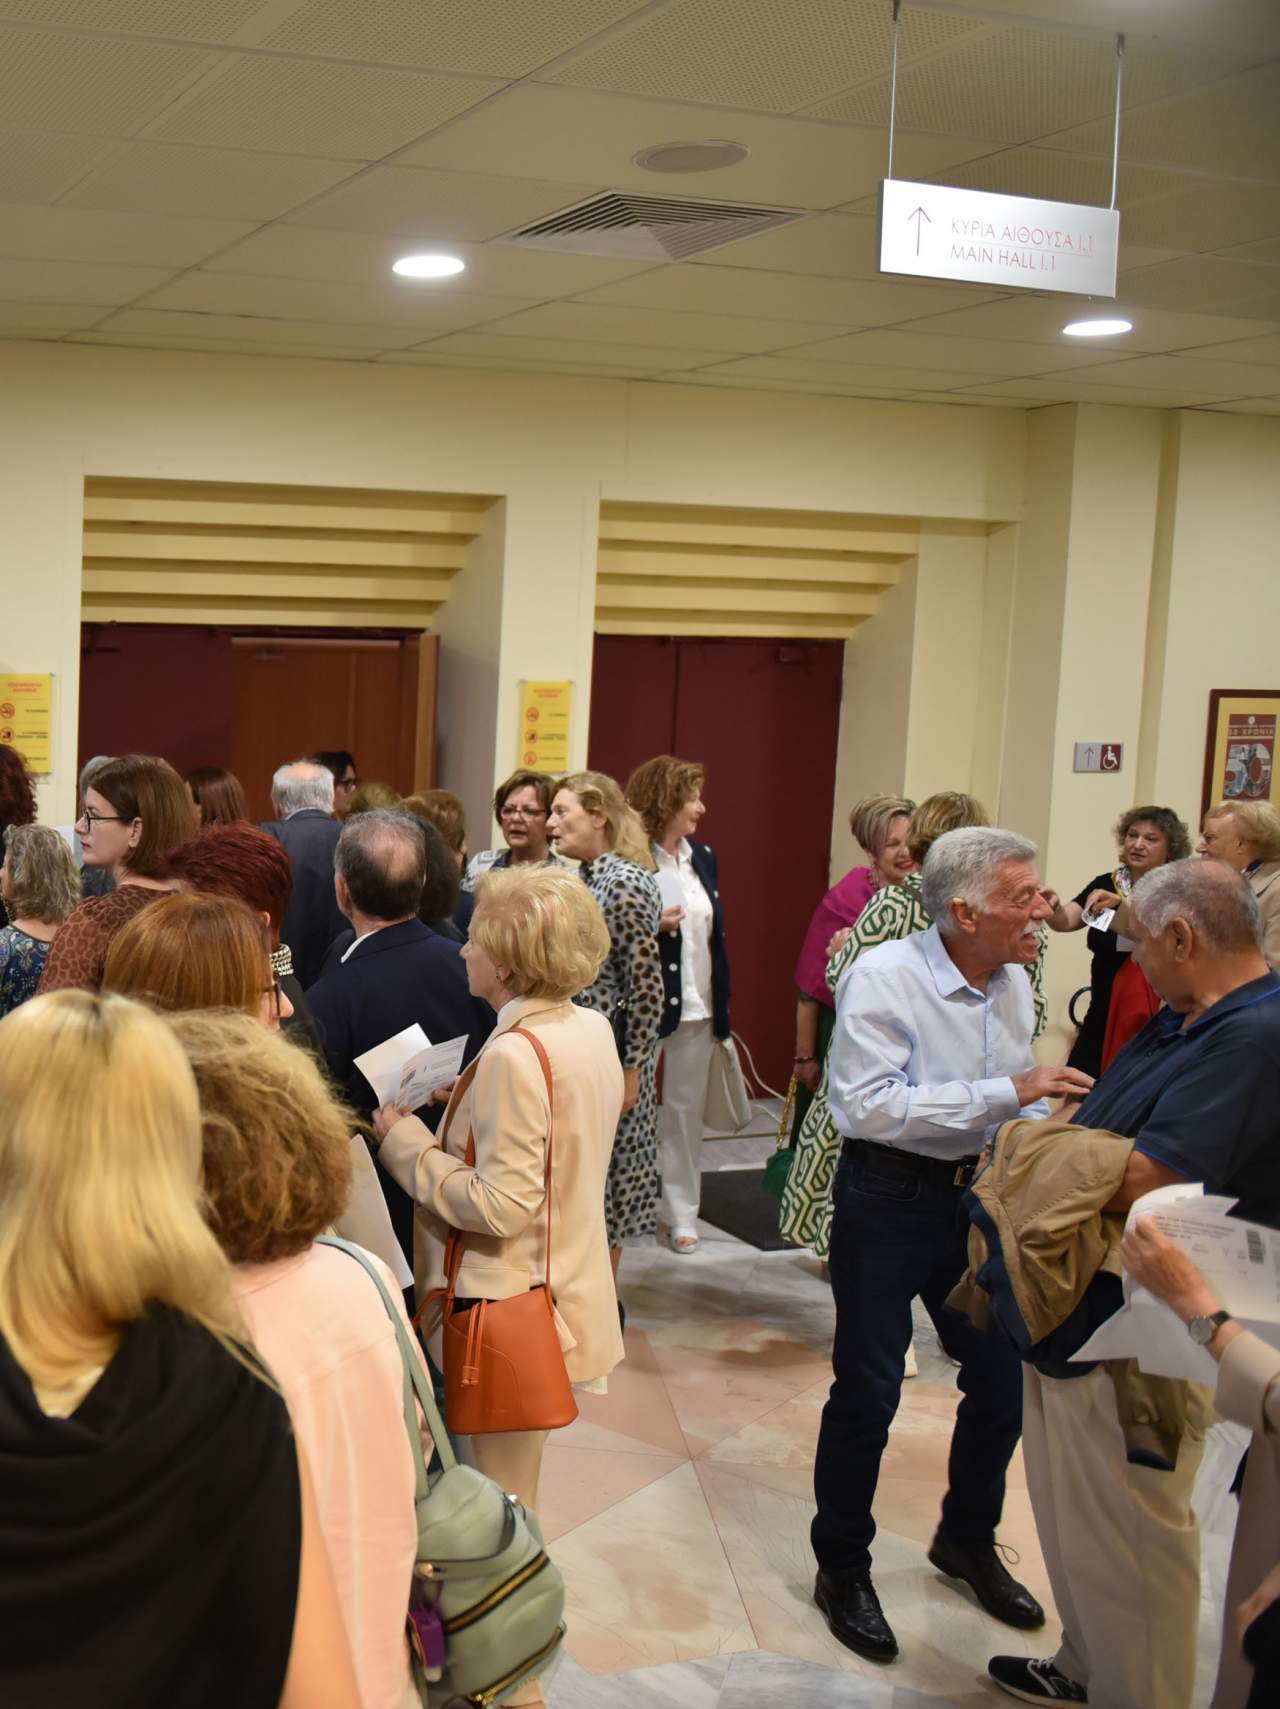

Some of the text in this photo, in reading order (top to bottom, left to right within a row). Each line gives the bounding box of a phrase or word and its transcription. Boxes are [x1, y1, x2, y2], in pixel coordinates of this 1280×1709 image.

[951, 217, 996, 239] ΚΥΡΙΑ
[1000, 225, 1073, 249] ΑΙΘΟΥΣΑ
[950, 245, 993, 264] MAIN
[998, 249, 1036, 270] HALL
[1224, 744, 1271, 797] 50
